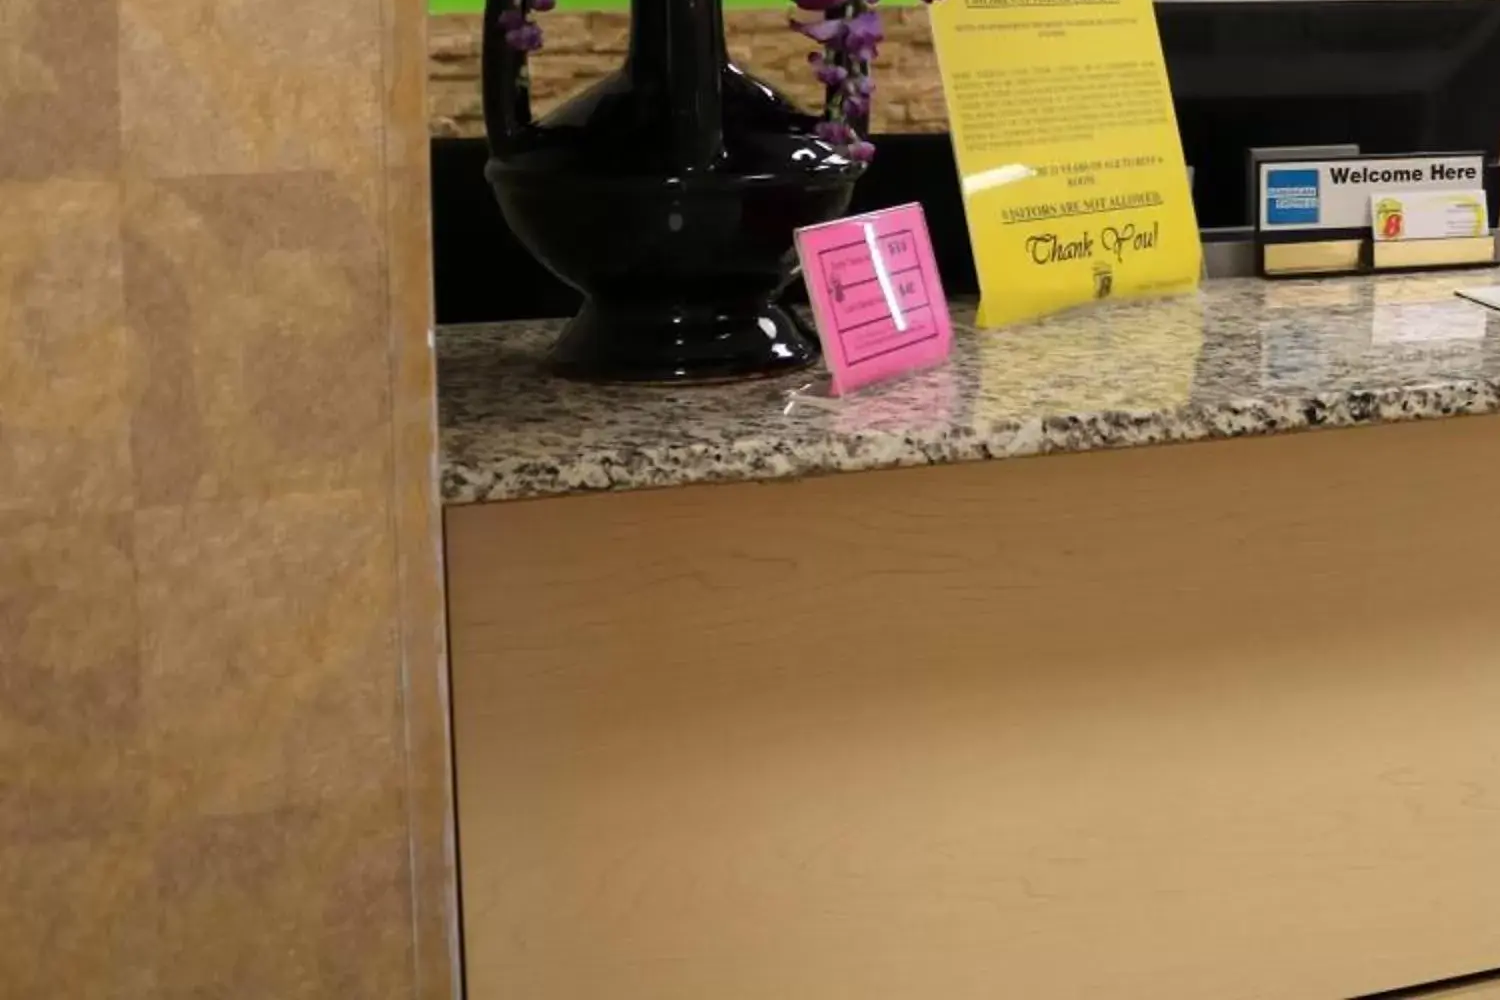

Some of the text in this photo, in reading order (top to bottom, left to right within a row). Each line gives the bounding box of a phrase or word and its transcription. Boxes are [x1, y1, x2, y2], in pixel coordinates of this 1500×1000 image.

[1329, 163, 1477, 184] Welcome Here
[1001, 203, 1057, 220] VISITORS
[1025, 221, 1159, 265] Thank You!
